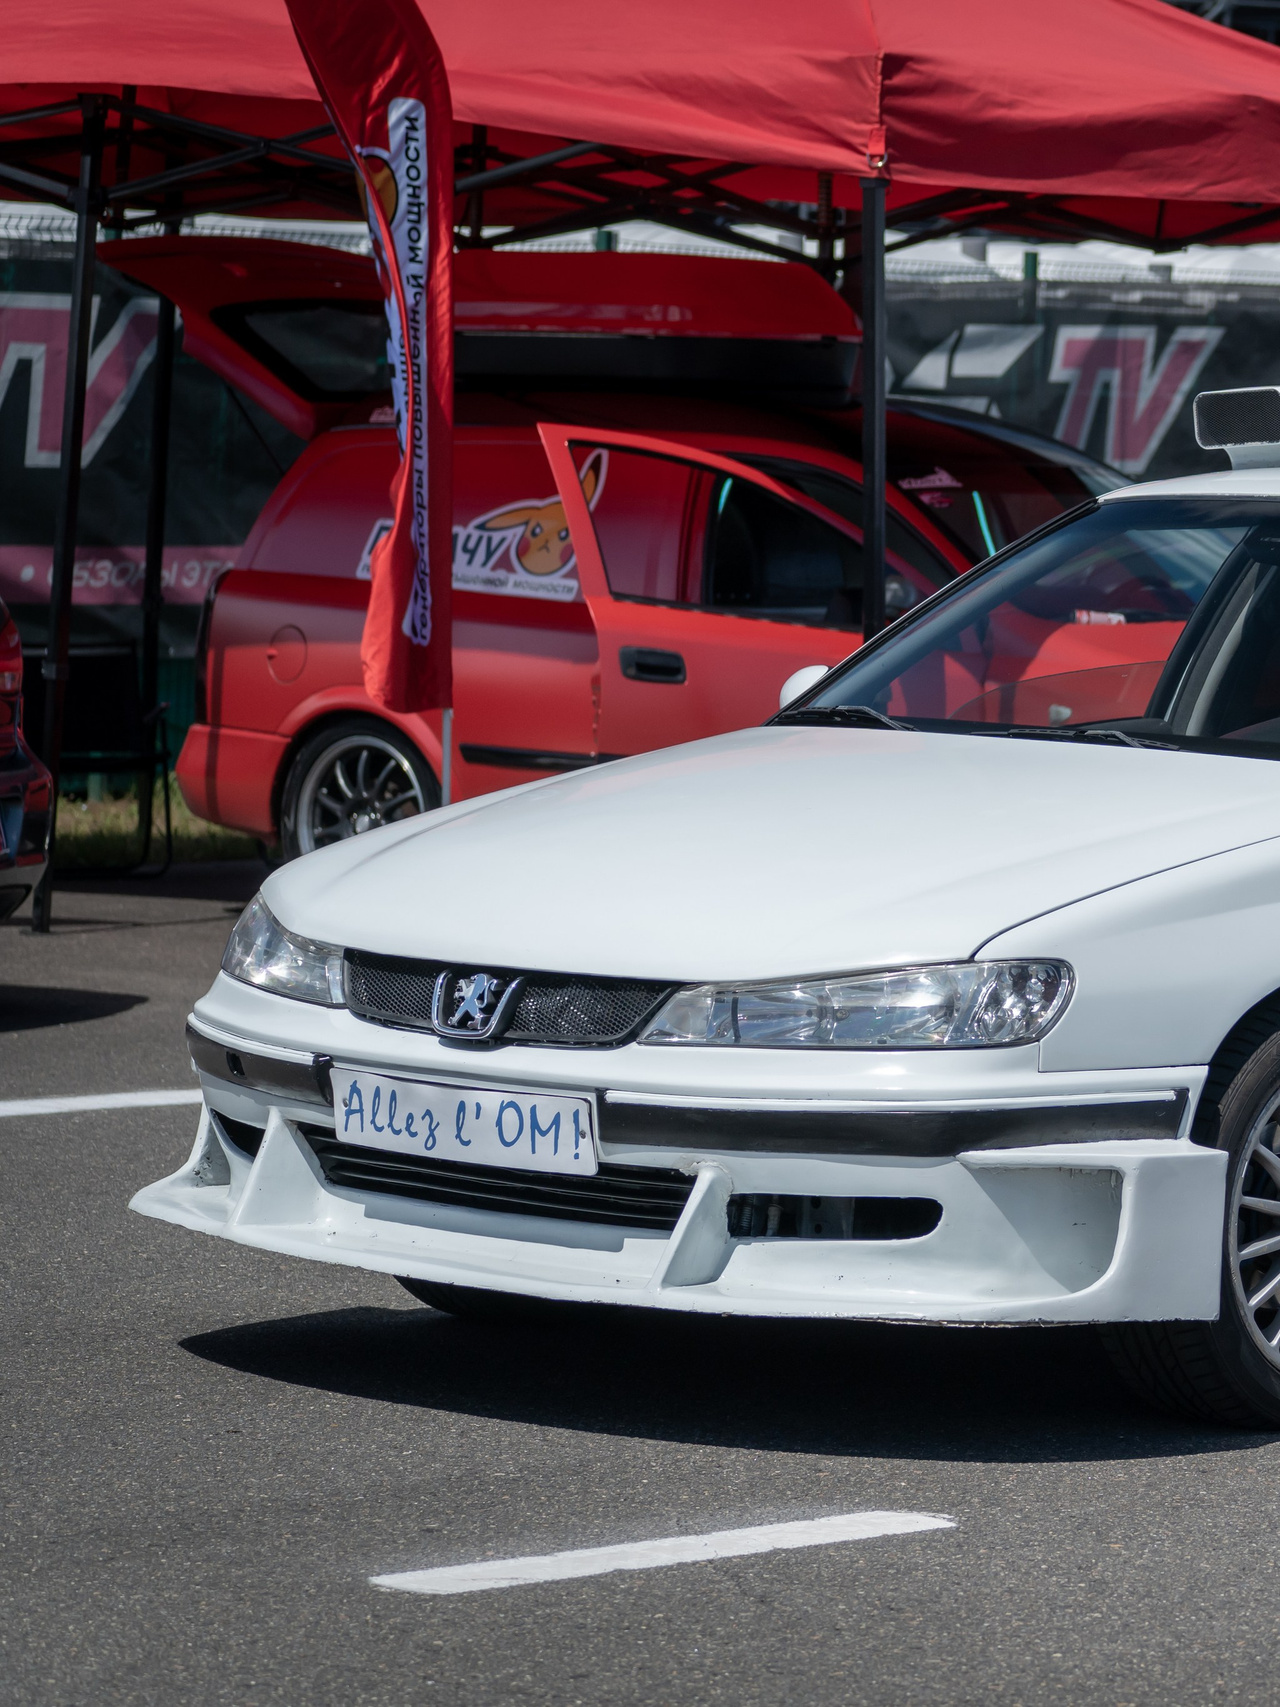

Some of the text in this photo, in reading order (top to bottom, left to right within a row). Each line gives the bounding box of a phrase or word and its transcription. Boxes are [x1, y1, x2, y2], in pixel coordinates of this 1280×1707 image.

[404, 115, 425, 265] мощности
[1048, 325, 1227, 476] TV
[344, 1079, 440, 1151] Allez
